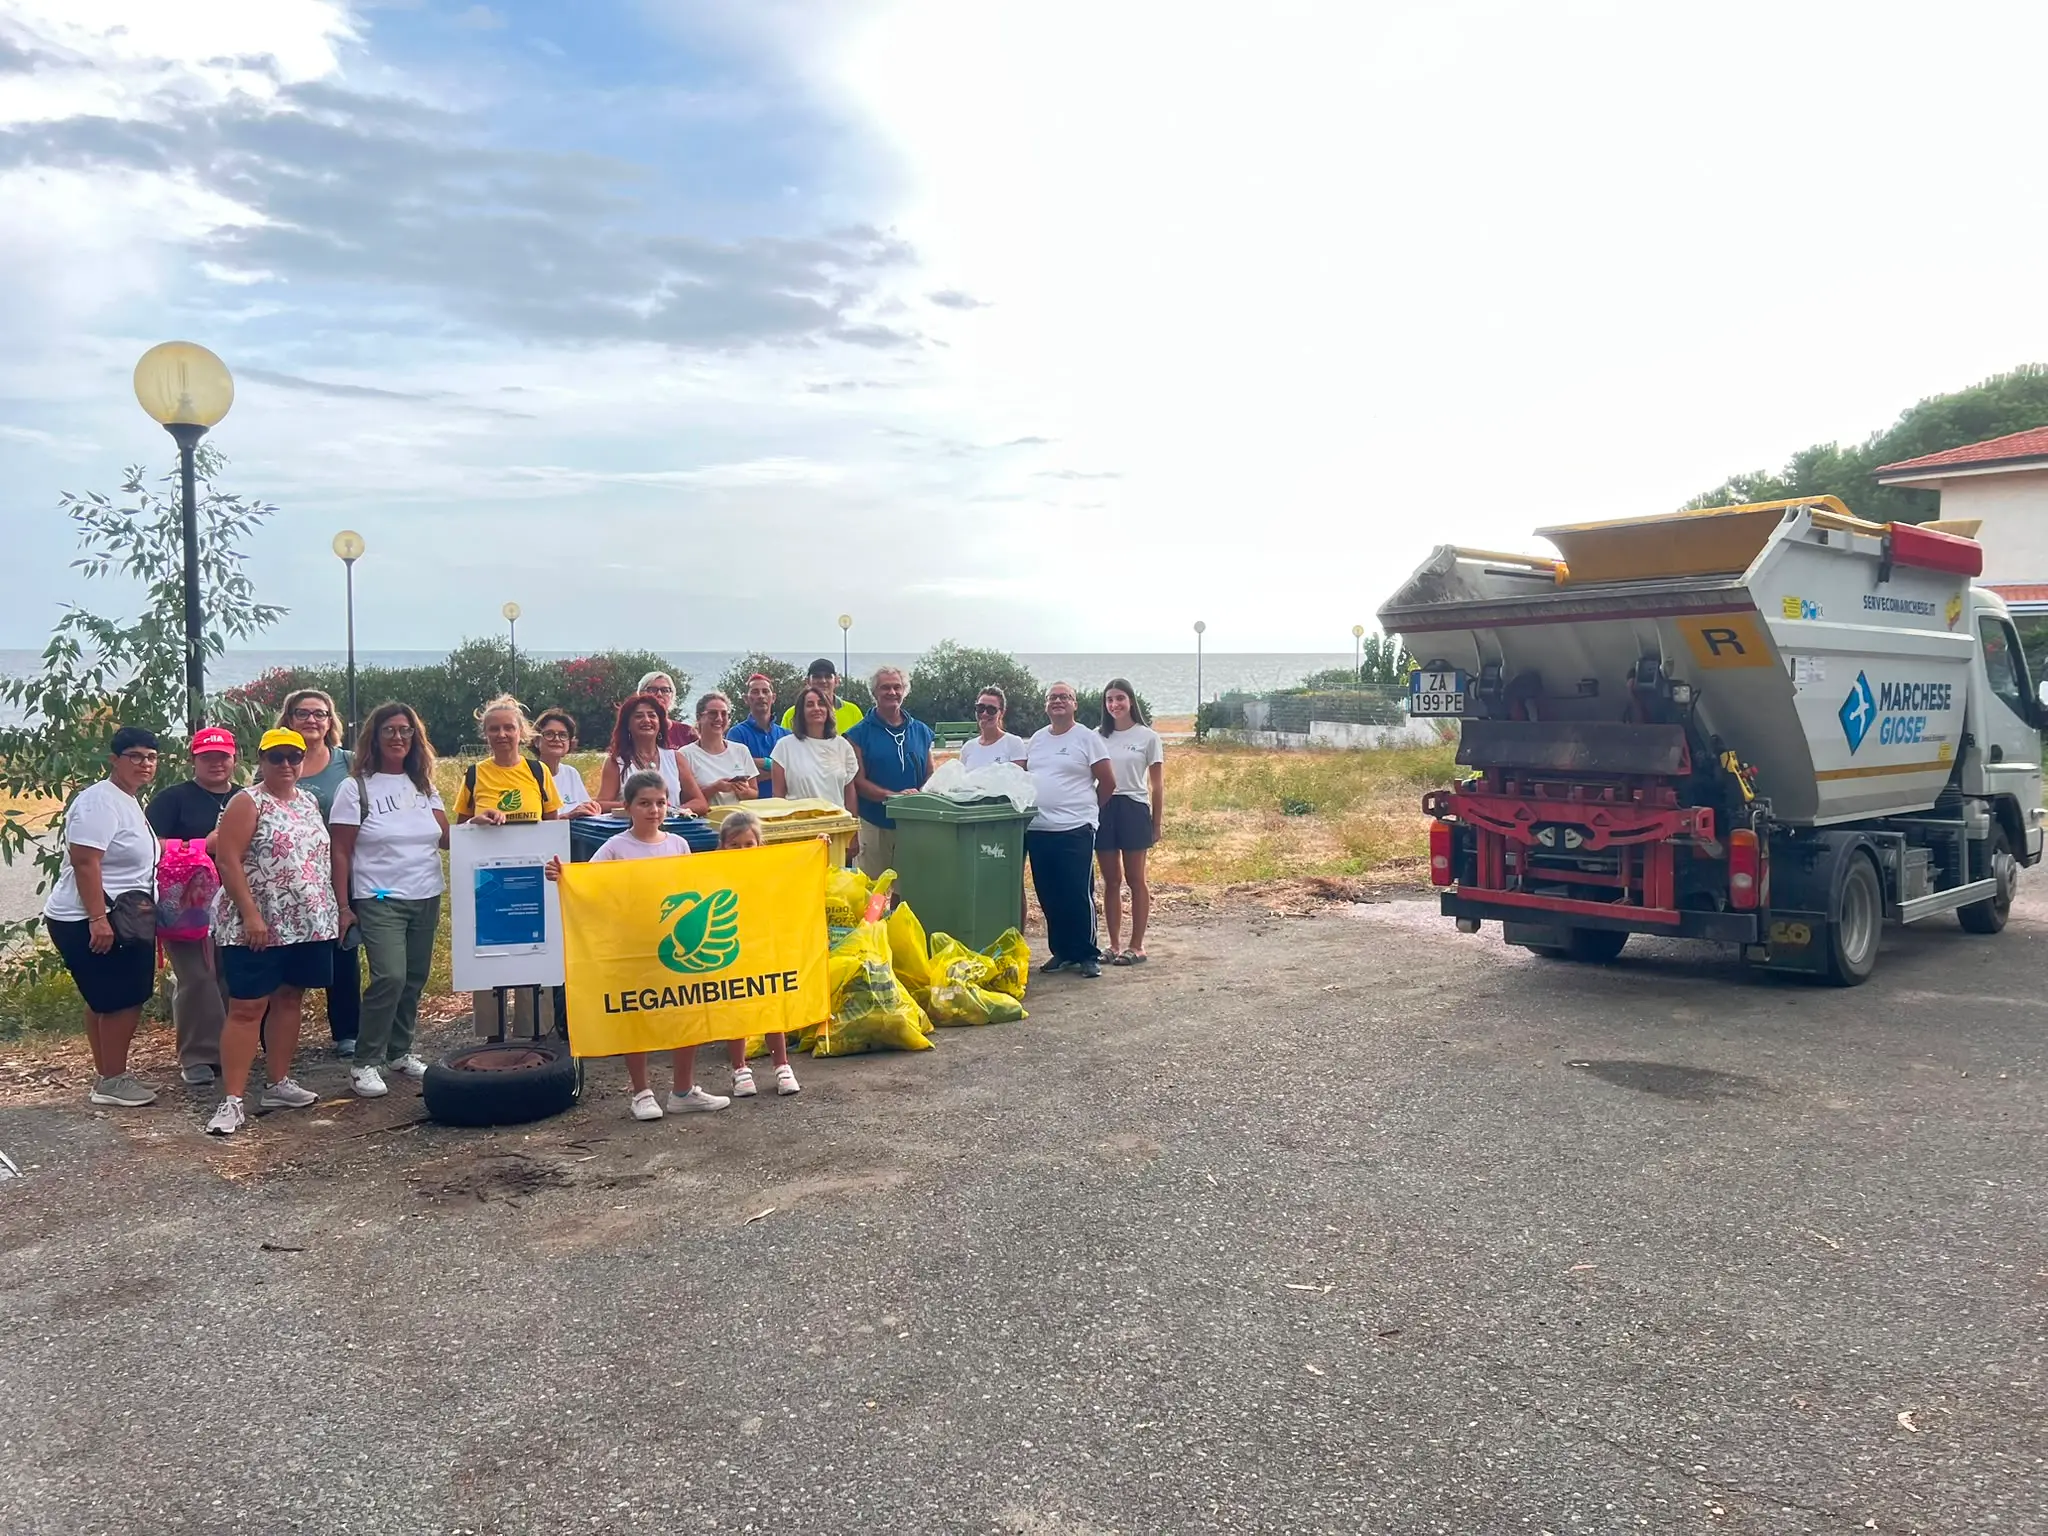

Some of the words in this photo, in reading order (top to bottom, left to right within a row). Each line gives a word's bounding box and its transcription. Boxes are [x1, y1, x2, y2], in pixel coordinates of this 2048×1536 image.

[1701, 628, 1746, 656] R
[1429, 673, 1447, 691] ZA
[1880, 682, 1952, 711] MARCHESE
[604, 970, 799, 1014] LEGAMBIENTE
